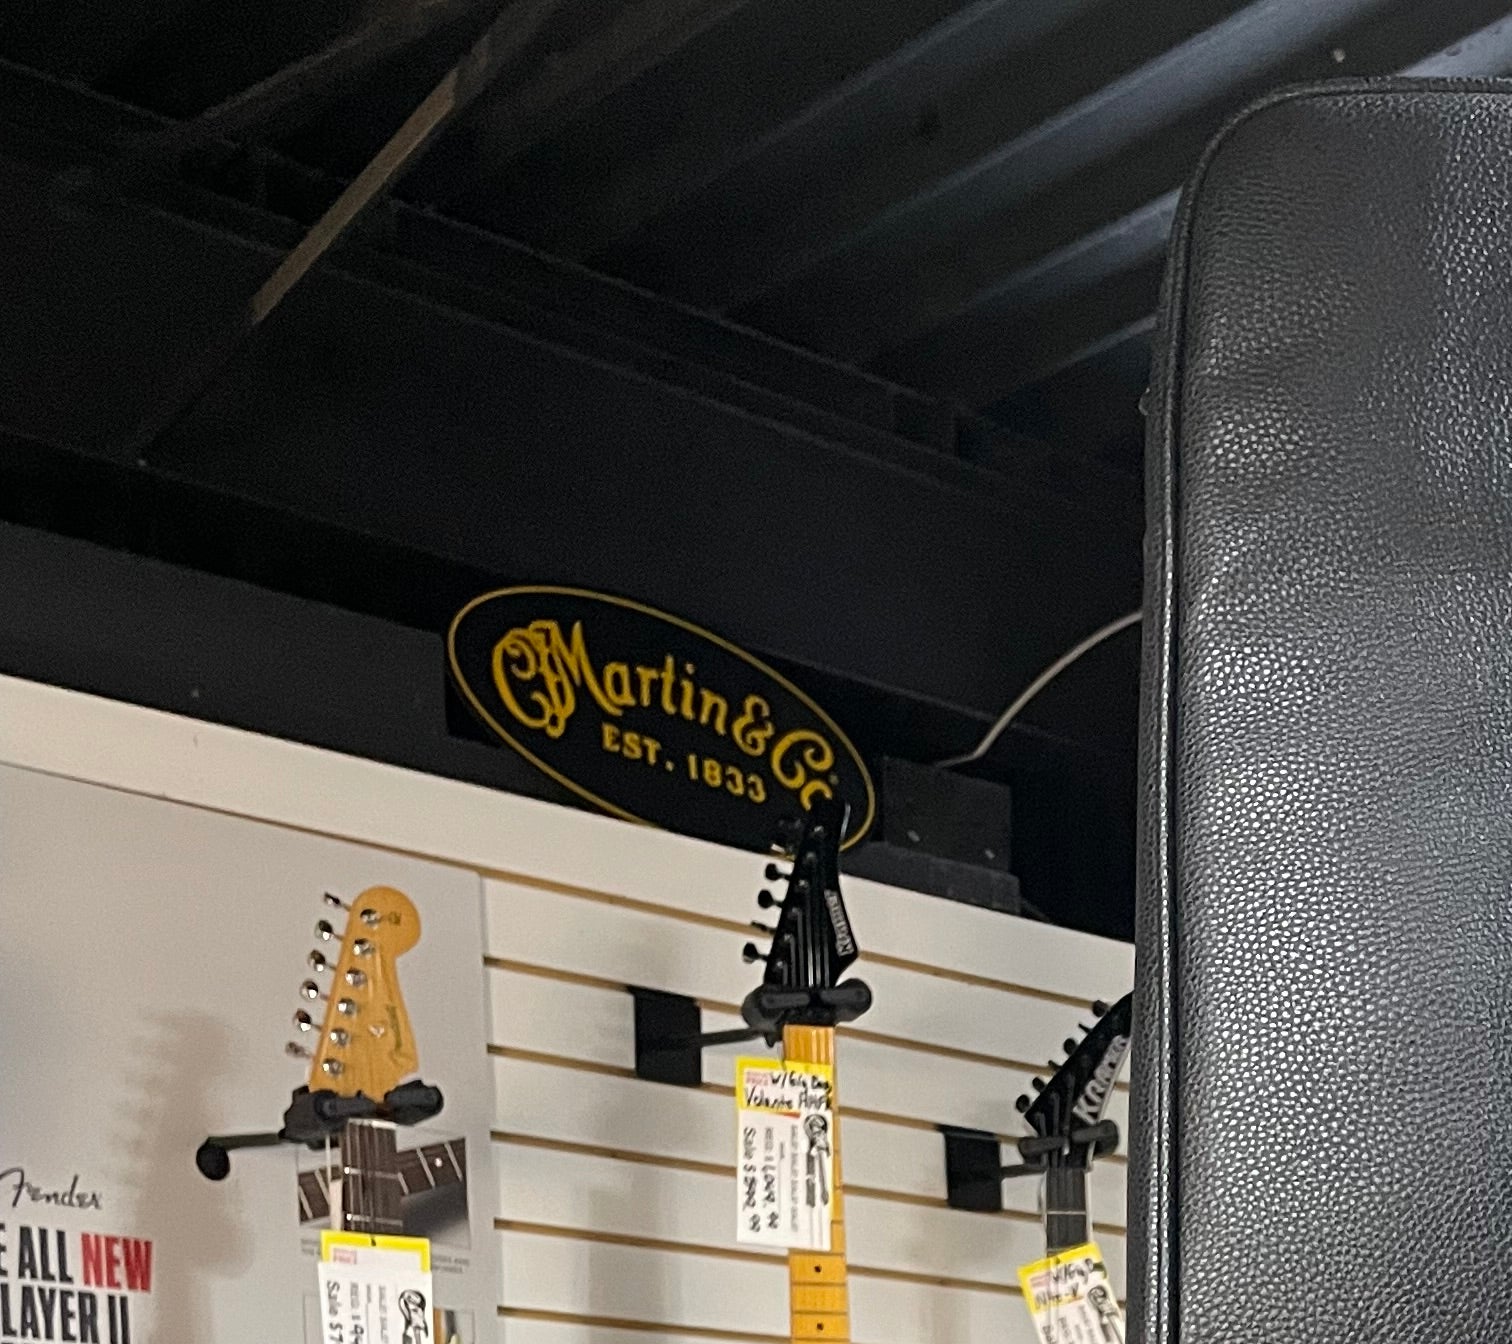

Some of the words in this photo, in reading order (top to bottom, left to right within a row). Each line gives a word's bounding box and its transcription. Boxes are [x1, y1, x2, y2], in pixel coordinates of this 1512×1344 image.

[688, 753, 766, 804] 1833
[0, 1167, 101, 1210] Fender
[18, 1225, 74, 1282] ALL
[81, 1232, 152, 1292] NEW
[0, 1283, 100, 1344] LAYER
